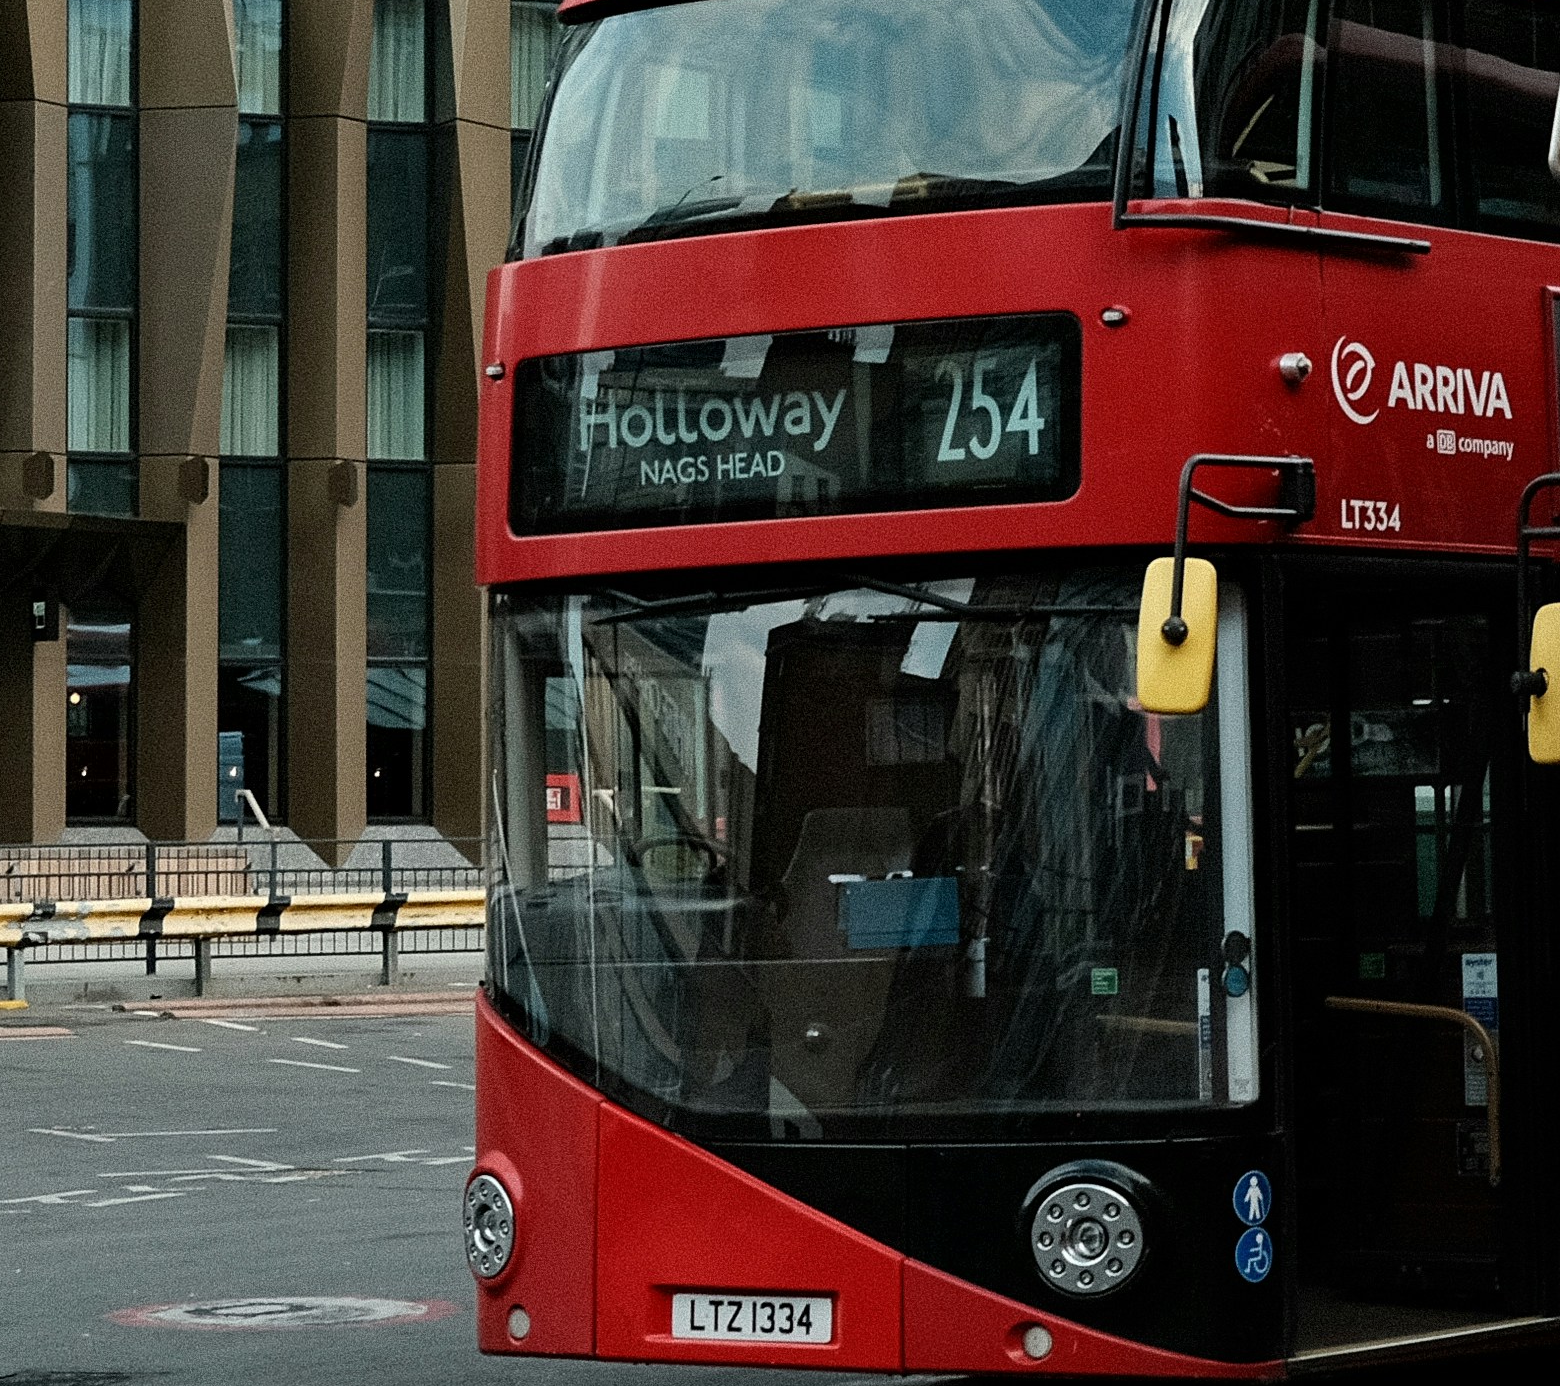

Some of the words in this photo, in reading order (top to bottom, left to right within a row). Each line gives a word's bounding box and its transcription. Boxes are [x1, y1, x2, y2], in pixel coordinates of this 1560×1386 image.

[1387, 360, 1514, 420] ARRIVA
[579, 385, 846, 453] Holloway
[938, 358, 1046, 462] 254
[1426, 434, 1434, 449] a
[1437, 430, 1456, 454] DB
[1458, 437, 1515, 461] company
[641, 455, 709, 486] NAGS
[717, 450, 786, 480] HEAD
[1341, 498, 1401, 532] LT334
[690, 1299, 743, 1333] LTZ
[751, 1301, 813, 1335] 1334
